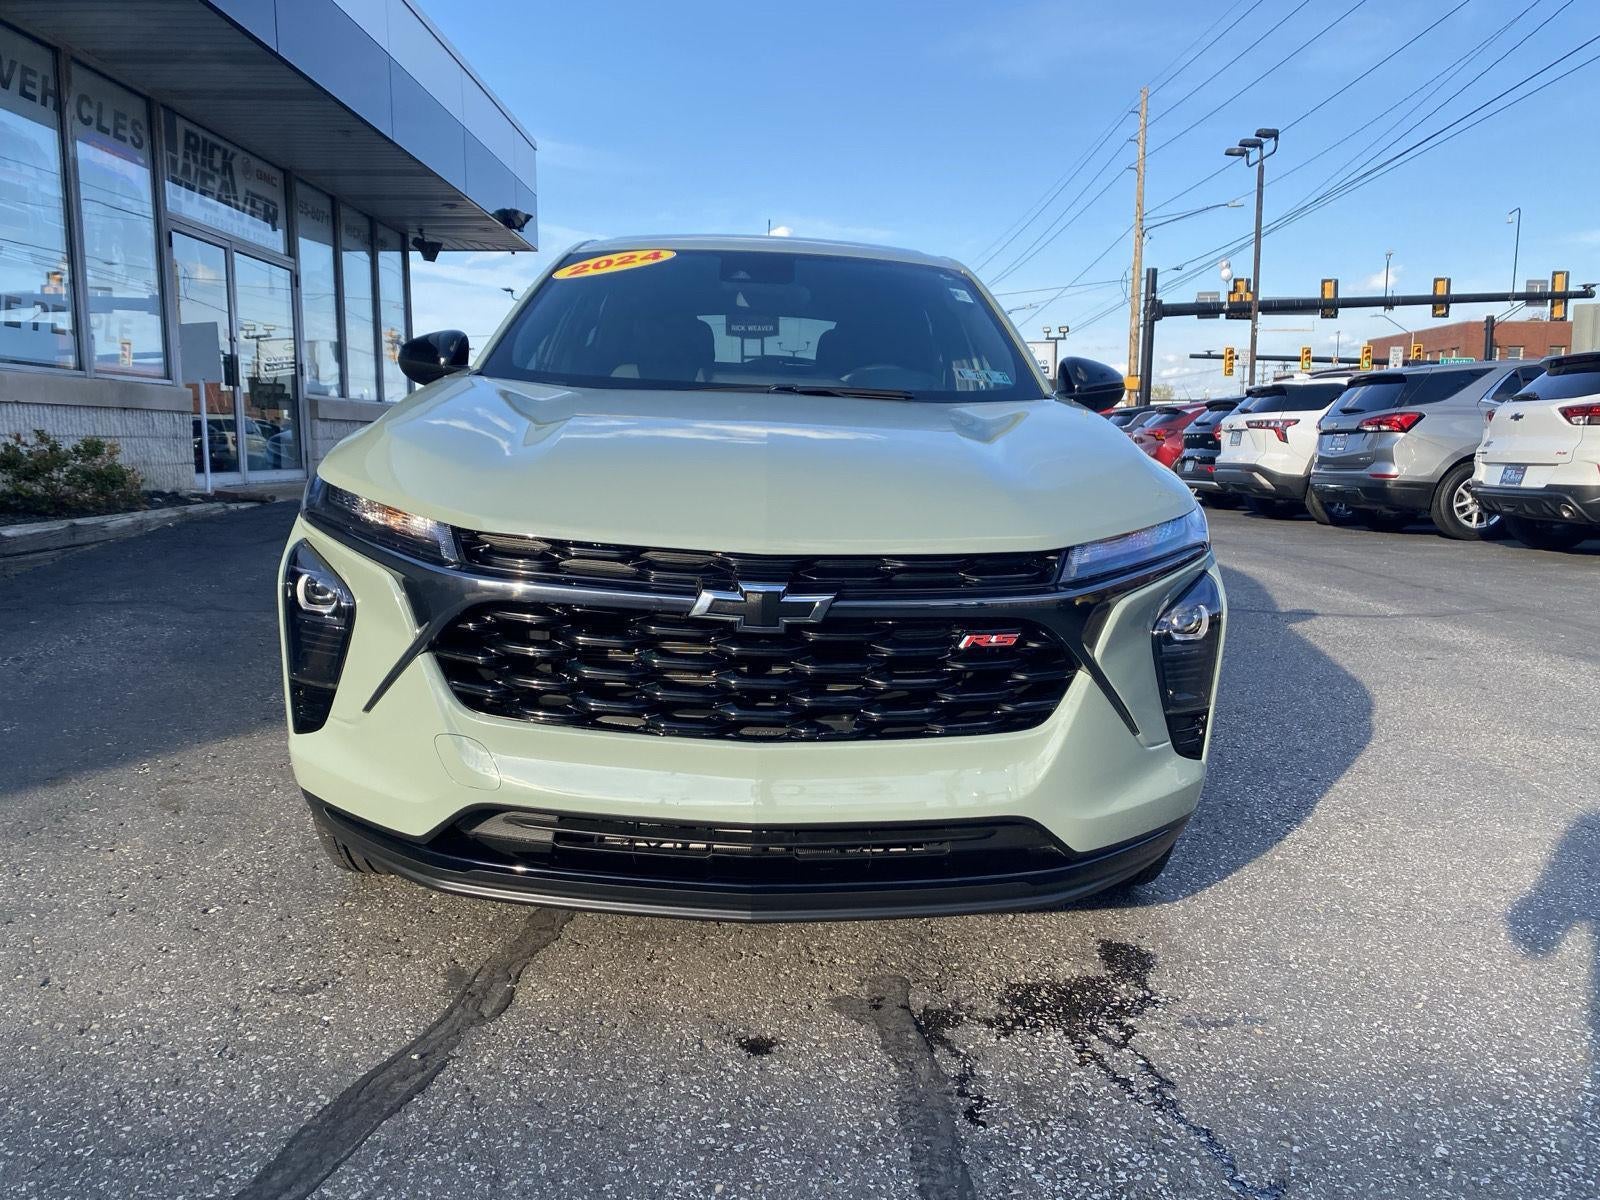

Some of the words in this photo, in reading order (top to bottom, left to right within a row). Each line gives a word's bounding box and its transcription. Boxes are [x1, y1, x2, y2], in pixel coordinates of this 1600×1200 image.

[0, 54, 144, 150] VEHCLES
[184, 127, 237, 177] RICK
[256, 168, 278, 188] GMC
[168, 152, 279, 232] WEAVER
[567, 251, 663, 277] 2024
[731, 324, 746, 332] RICK
[748, 324, 774, 332] WEAVER
[958, 633, 1019, 650] RS
